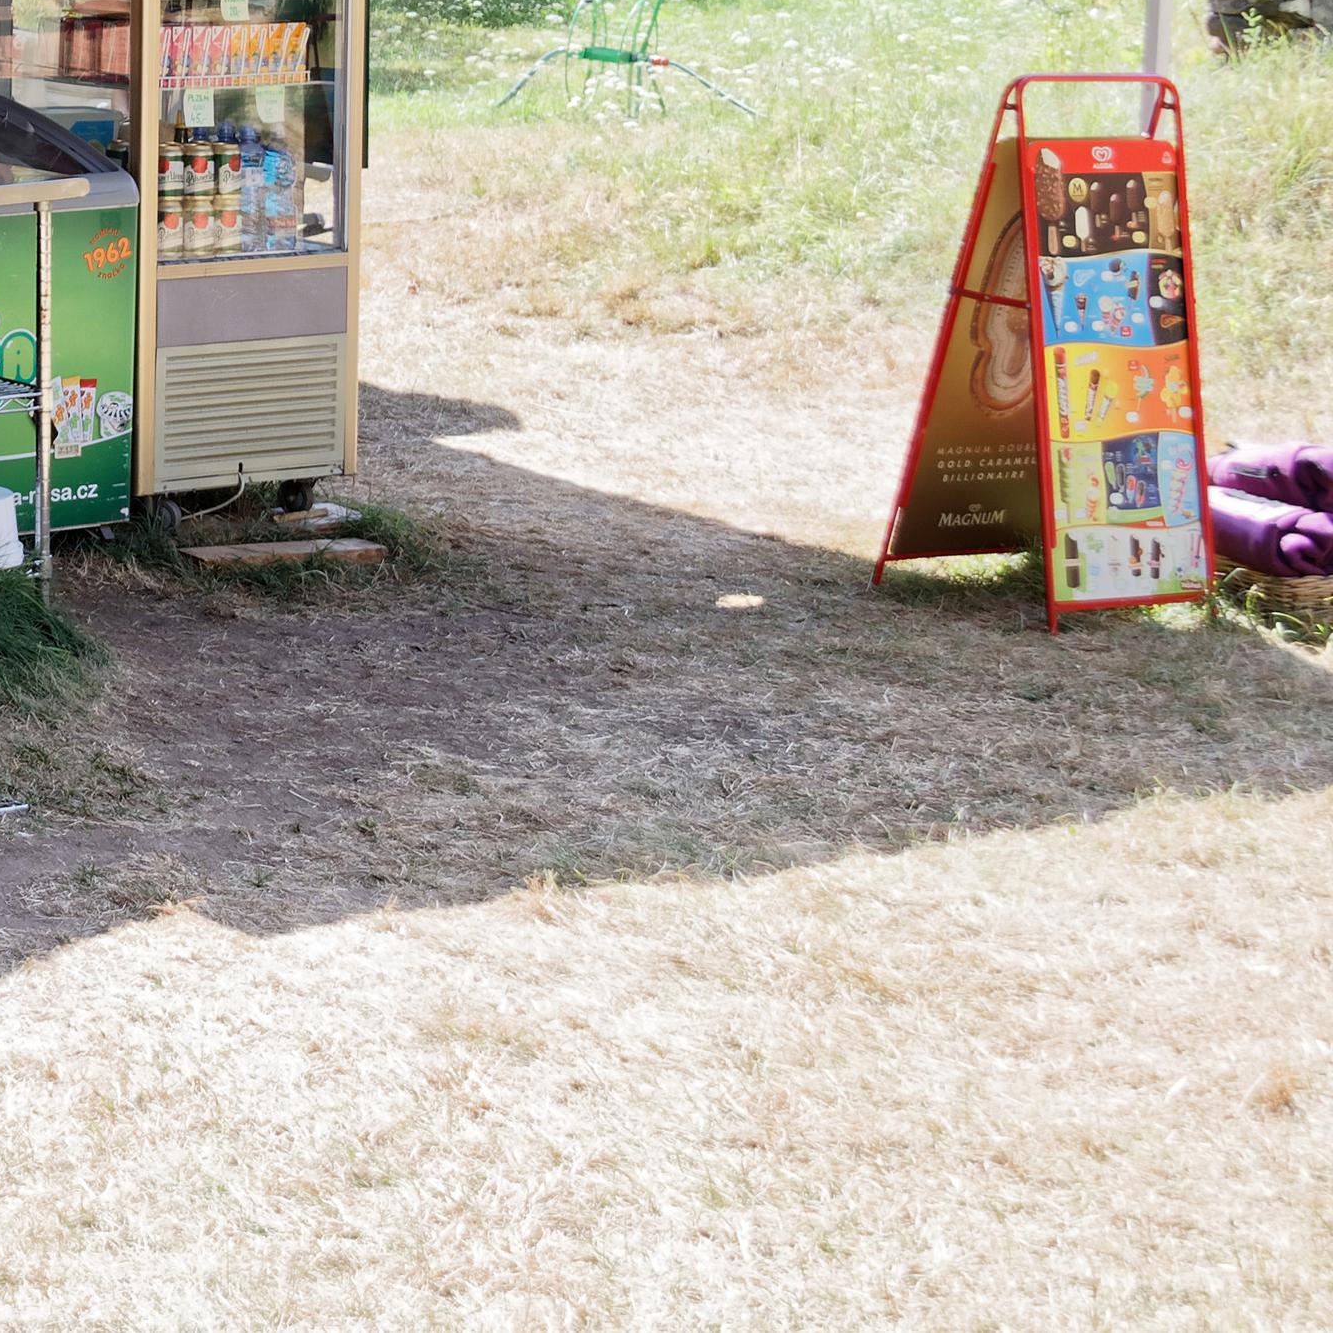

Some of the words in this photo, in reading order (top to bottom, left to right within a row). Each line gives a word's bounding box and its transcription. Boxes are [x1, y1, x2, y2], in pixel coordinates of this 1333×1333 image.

[84, 236, 133, 273] 1962
[936, 446, 990, 455] MAGNUM
[997, 443, 1037, 453] DOUBL
[937, 459, 971, 469] GOLD
[979, 457, 1037, 467] CARAMEL
[942, 470, 1025, 483] BILLIONAIRE
[938, 509, 1007, 527] MAGNUM
